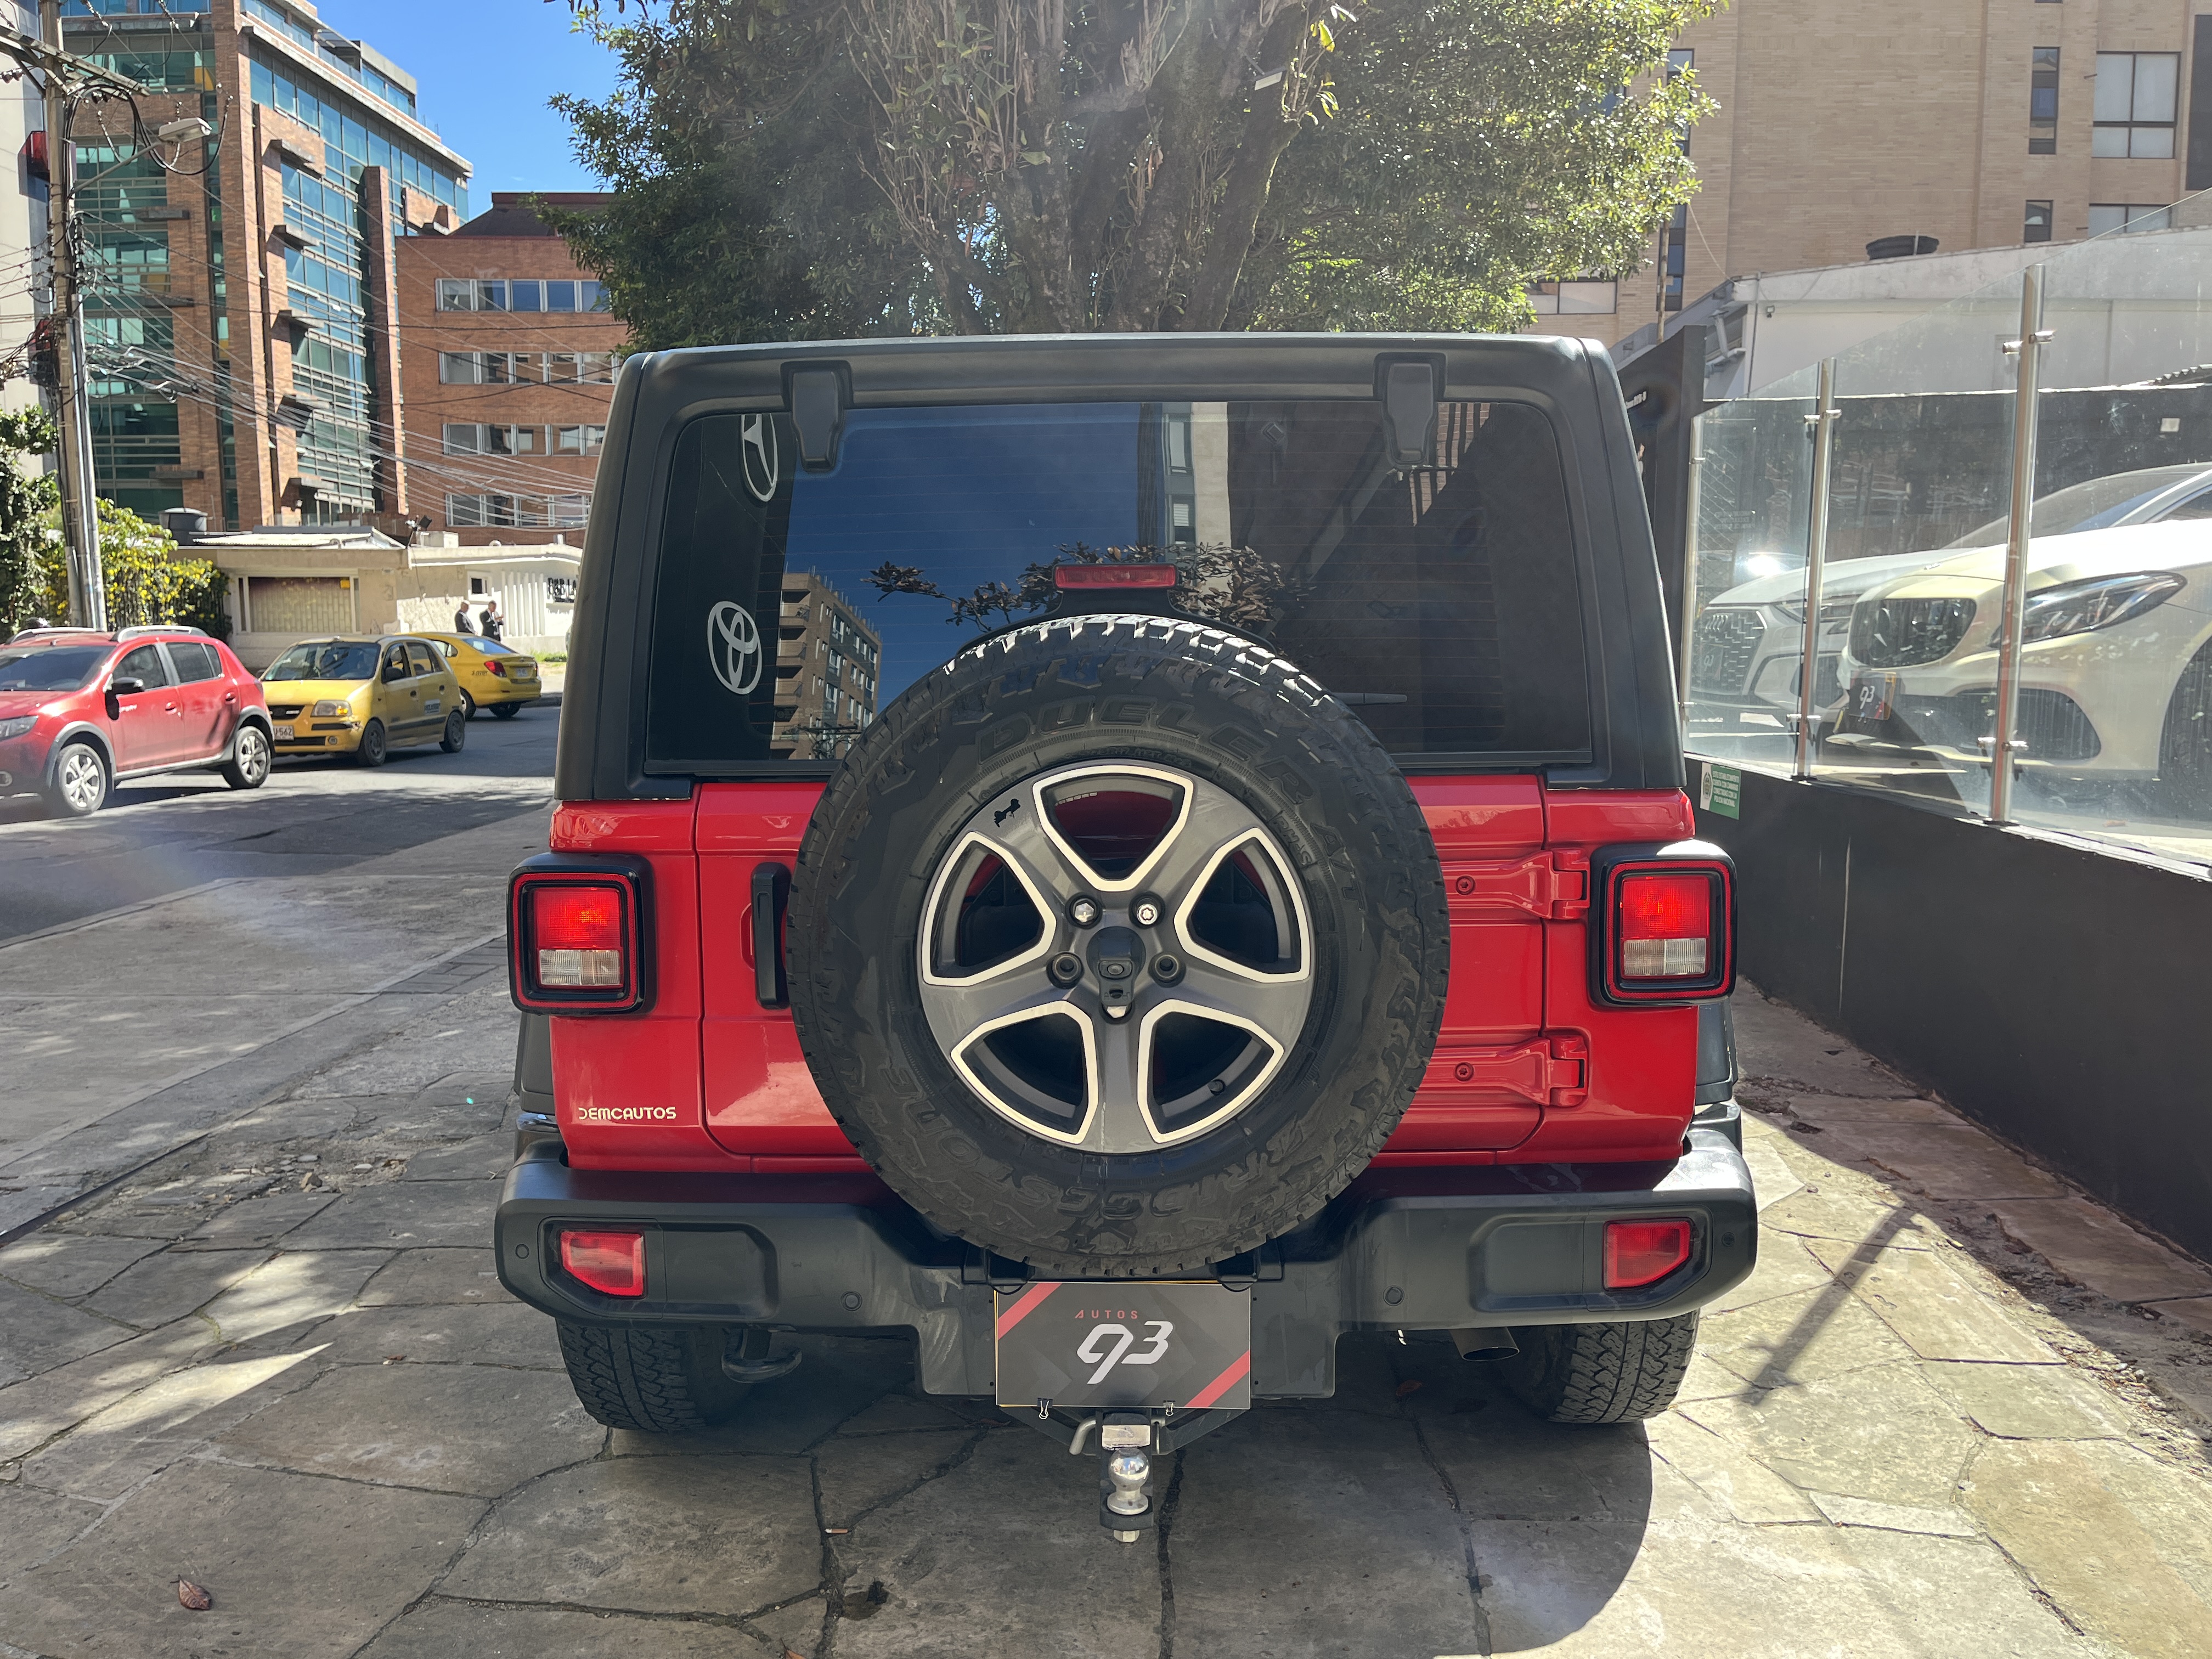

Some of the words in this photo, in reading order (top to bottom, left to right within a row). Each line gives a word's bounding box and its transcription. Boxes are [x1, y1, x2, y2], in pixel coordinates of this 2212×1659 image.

[1859, 685, 1875, 709] 93
[1075, 1310, 1138, 1319] AUTOS
[1076, 1321, 1173, 1385] 93
